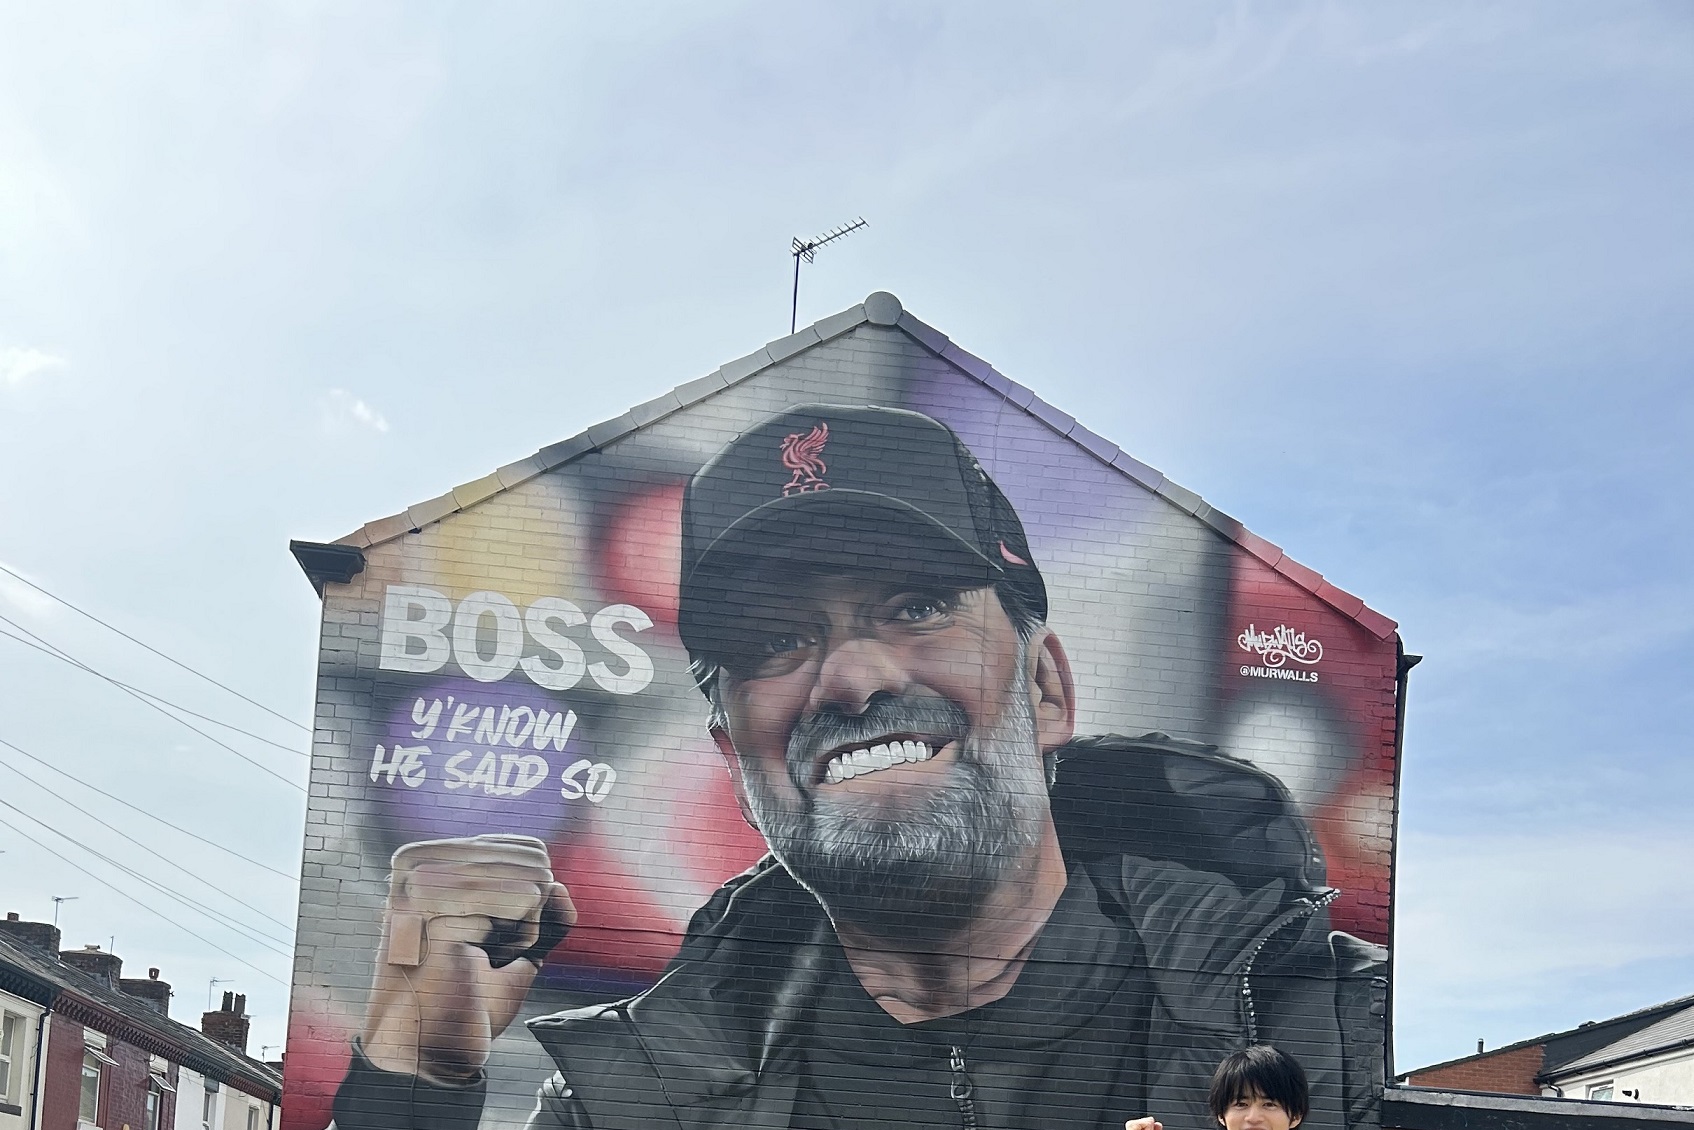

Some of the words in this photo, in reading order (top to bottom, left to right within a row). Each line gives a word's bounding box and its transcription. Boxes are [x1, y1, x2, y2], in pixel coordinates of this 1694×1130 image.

[379, 584, 655, 695] BOSS
[1240, 665, 1319, 682] @MURWALLS
[411, 696, 578, 752] Y'KNOW
[369, 744, 432, 788] HE
[443, 749, 550, 796] SAID
[560, 758, 618, 804] SO
